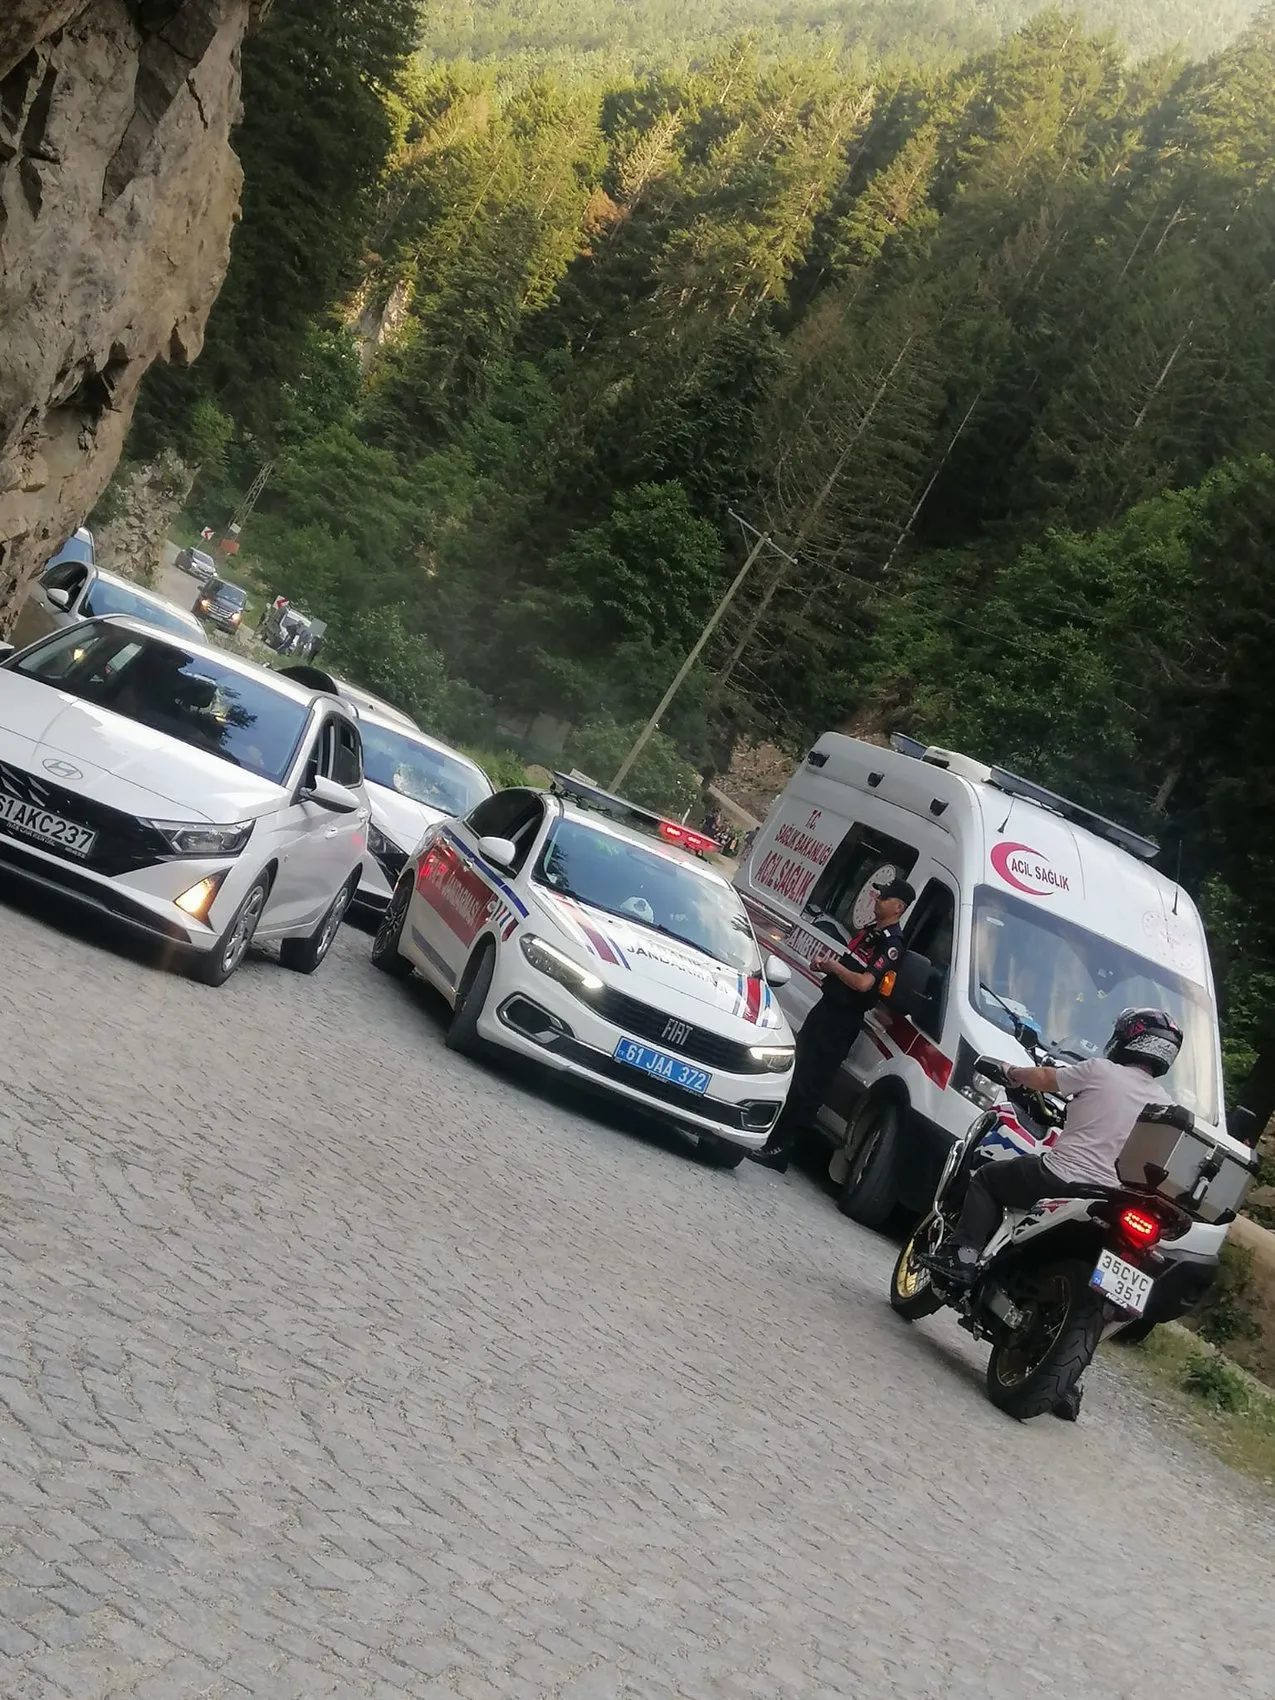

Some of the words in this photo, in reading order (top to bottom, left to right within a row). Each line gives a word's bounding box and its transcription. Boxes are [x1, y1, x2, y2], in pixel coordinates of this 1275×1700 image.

[775, 823, 801, 849] SAĞLIK
[793, 832, 834, 866] BAKANLIĞI
[773, 859, 816, 905] SAĞLIK
[1011, 858, 1033, 877] ACİL
[1035, 865, 1070, 892] SAĞLIK
[661, 1018, 693, 1045] FIAT
[626, 1044, 645, 1064] 61
[646, 1054, 673, 1077] JAA
[678, 1066, 706, 1090] 372
[1102, 1255, 1148, 1292] 35CVC
[1114, 1280, 1142, 1306] 351
